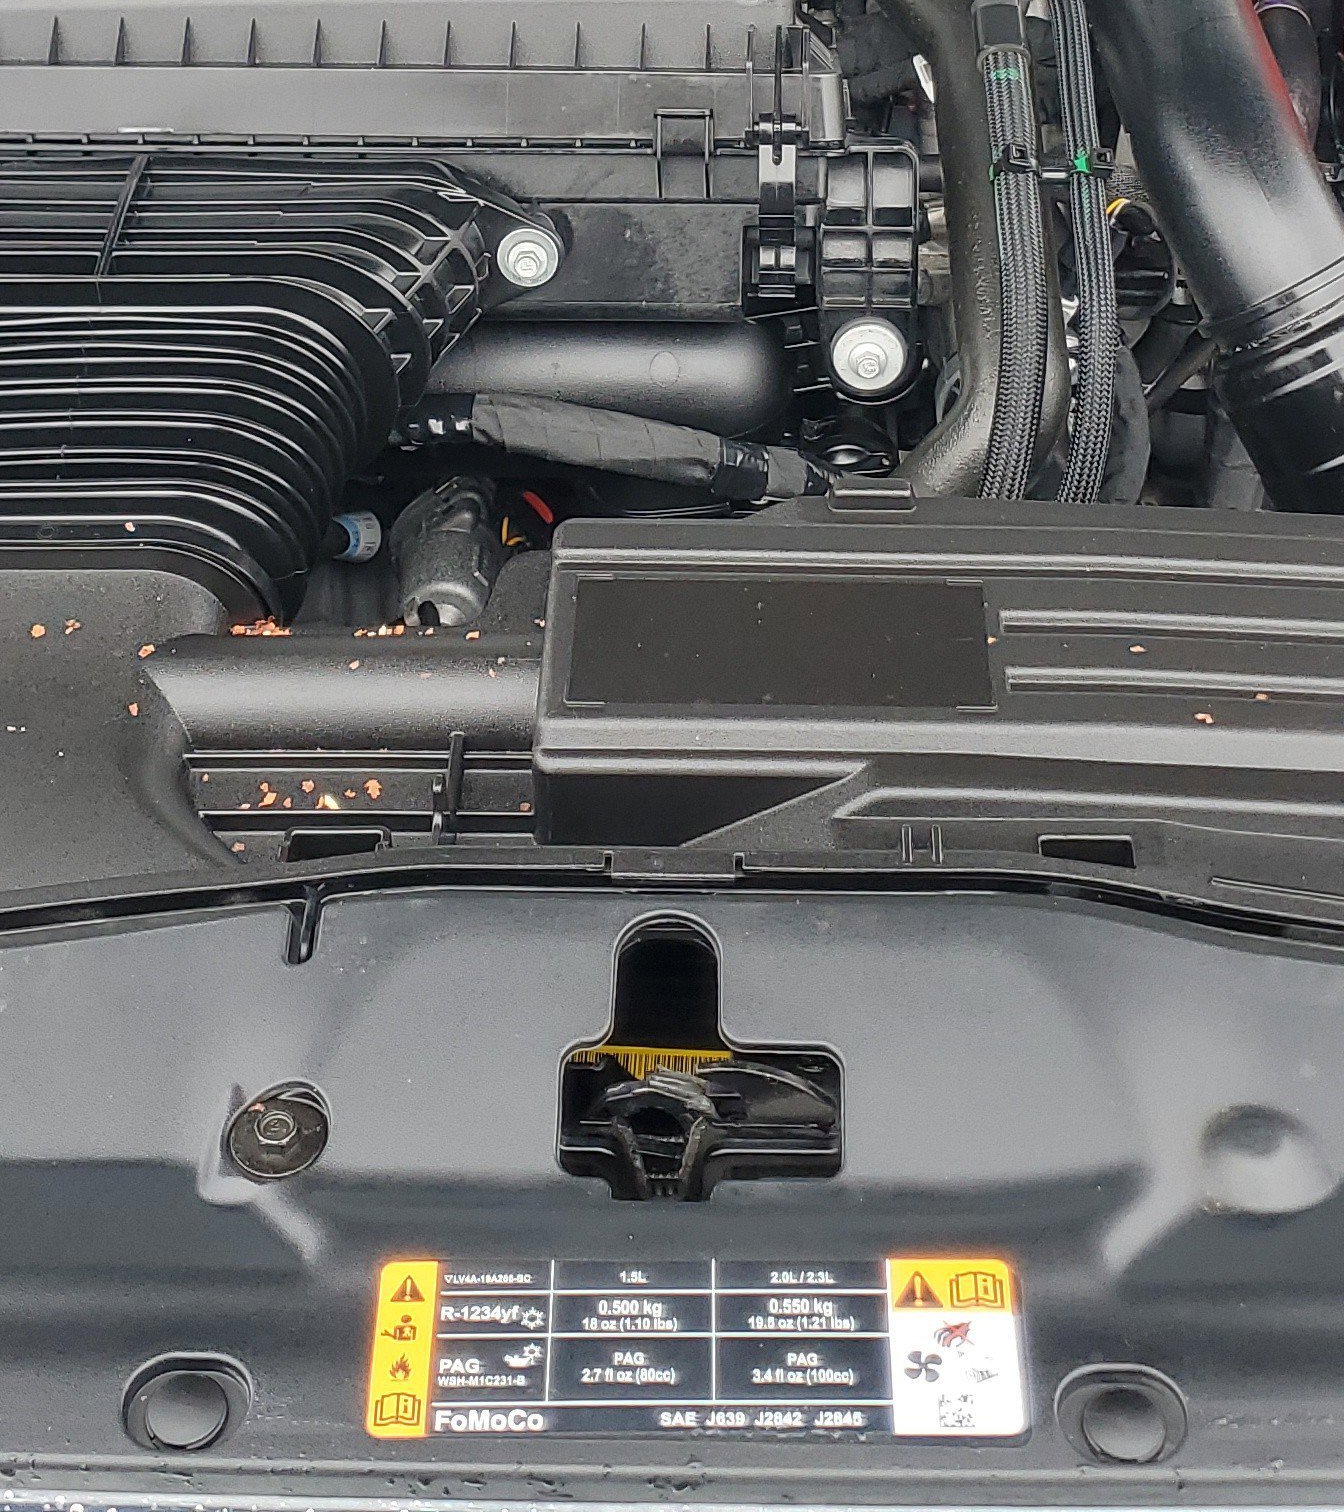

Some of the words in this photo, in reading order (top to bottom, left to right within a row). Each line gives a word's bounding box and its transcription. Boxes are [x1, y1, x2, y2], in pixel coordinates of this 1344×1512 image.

[619, 1270, 647, 1284] 1.5L
[770, 1271, 798, 1284] 2.0L
[806, 1271, 835, 1284] 2.3L
[440, 1305, 520, 1324] R-1234yf
[597, 1299, 640, 1316] 0.500
[642, 1299, 663, 1318] kg
[769, 1298, 810, 1314] 0.550
[813, 1297, 833, 1317] kg
[581, 1317, 598, 1331] 18
[600, 1319, 617, 1330] oz
[619, 1317, 650, 1332] (1.10
[653, 1317, 678, 1332] lbs)
[777, 1318, 795, 1329] oz
[796, 1316, 826, 1332] (1.21
[830, 1316, 855, 1332] lbs)
[438, 1358, 481, 1374] PAG
[613, 1351, 645, 1366] PAG
[787, 1352, 819, 1366] PAG
[580, 1368, 602, 1383] 2.7
[604, 1368, 614, 1382] fl
[616, 1370, 633, 1382] oz
[635, 1367, 676, 1385] (80cc)
[751, 1368, 772, 1383] 3.4
[774, 1368, 784, 1382] fl
[787, 1370, 804, 1382] oz
[434, 1409, 544, 1432] FoMoCo
[659, 1411, 697, 1427] SAE
[705, 1411, 746, 1427] J639
